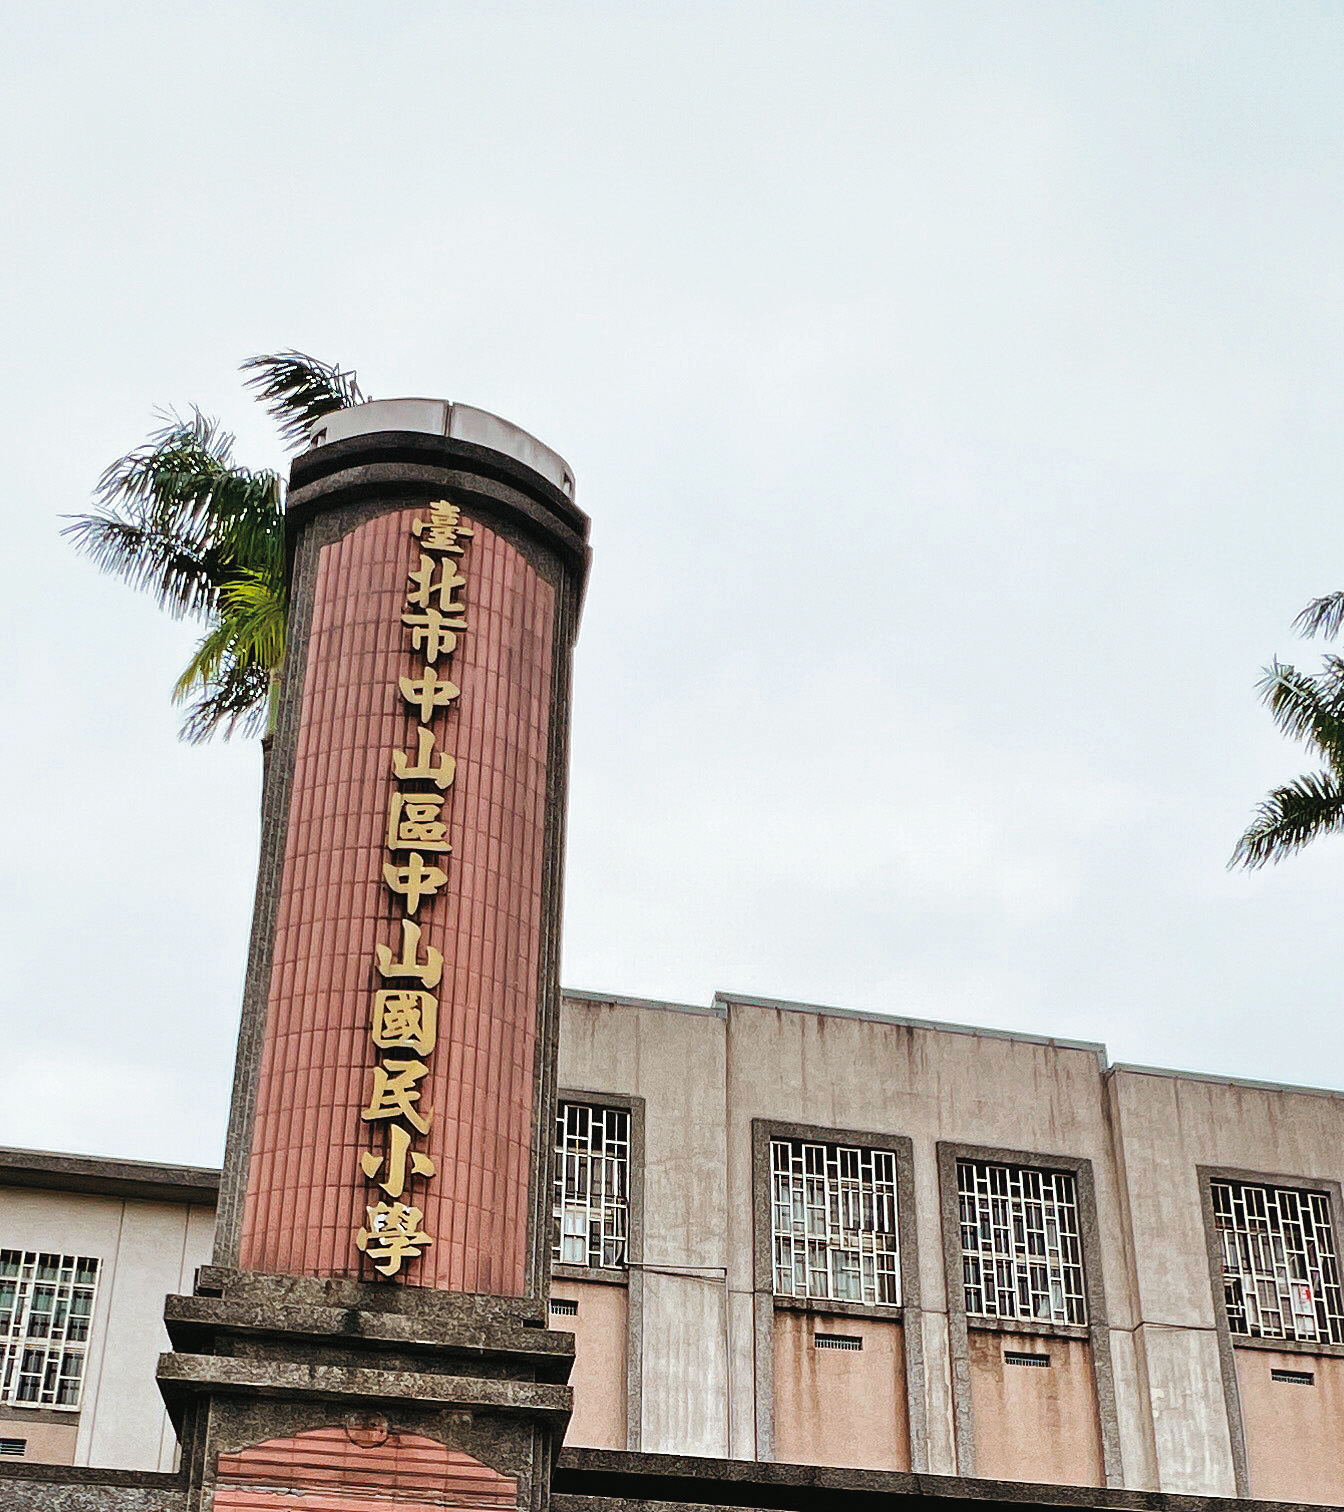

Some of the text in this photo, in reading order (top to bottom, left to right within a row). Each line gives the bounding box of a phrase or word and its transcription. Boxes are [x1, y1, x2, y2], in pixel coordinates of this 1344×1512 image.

[356, 498, 476, 1276] 臺北市中山區中山國民小學
